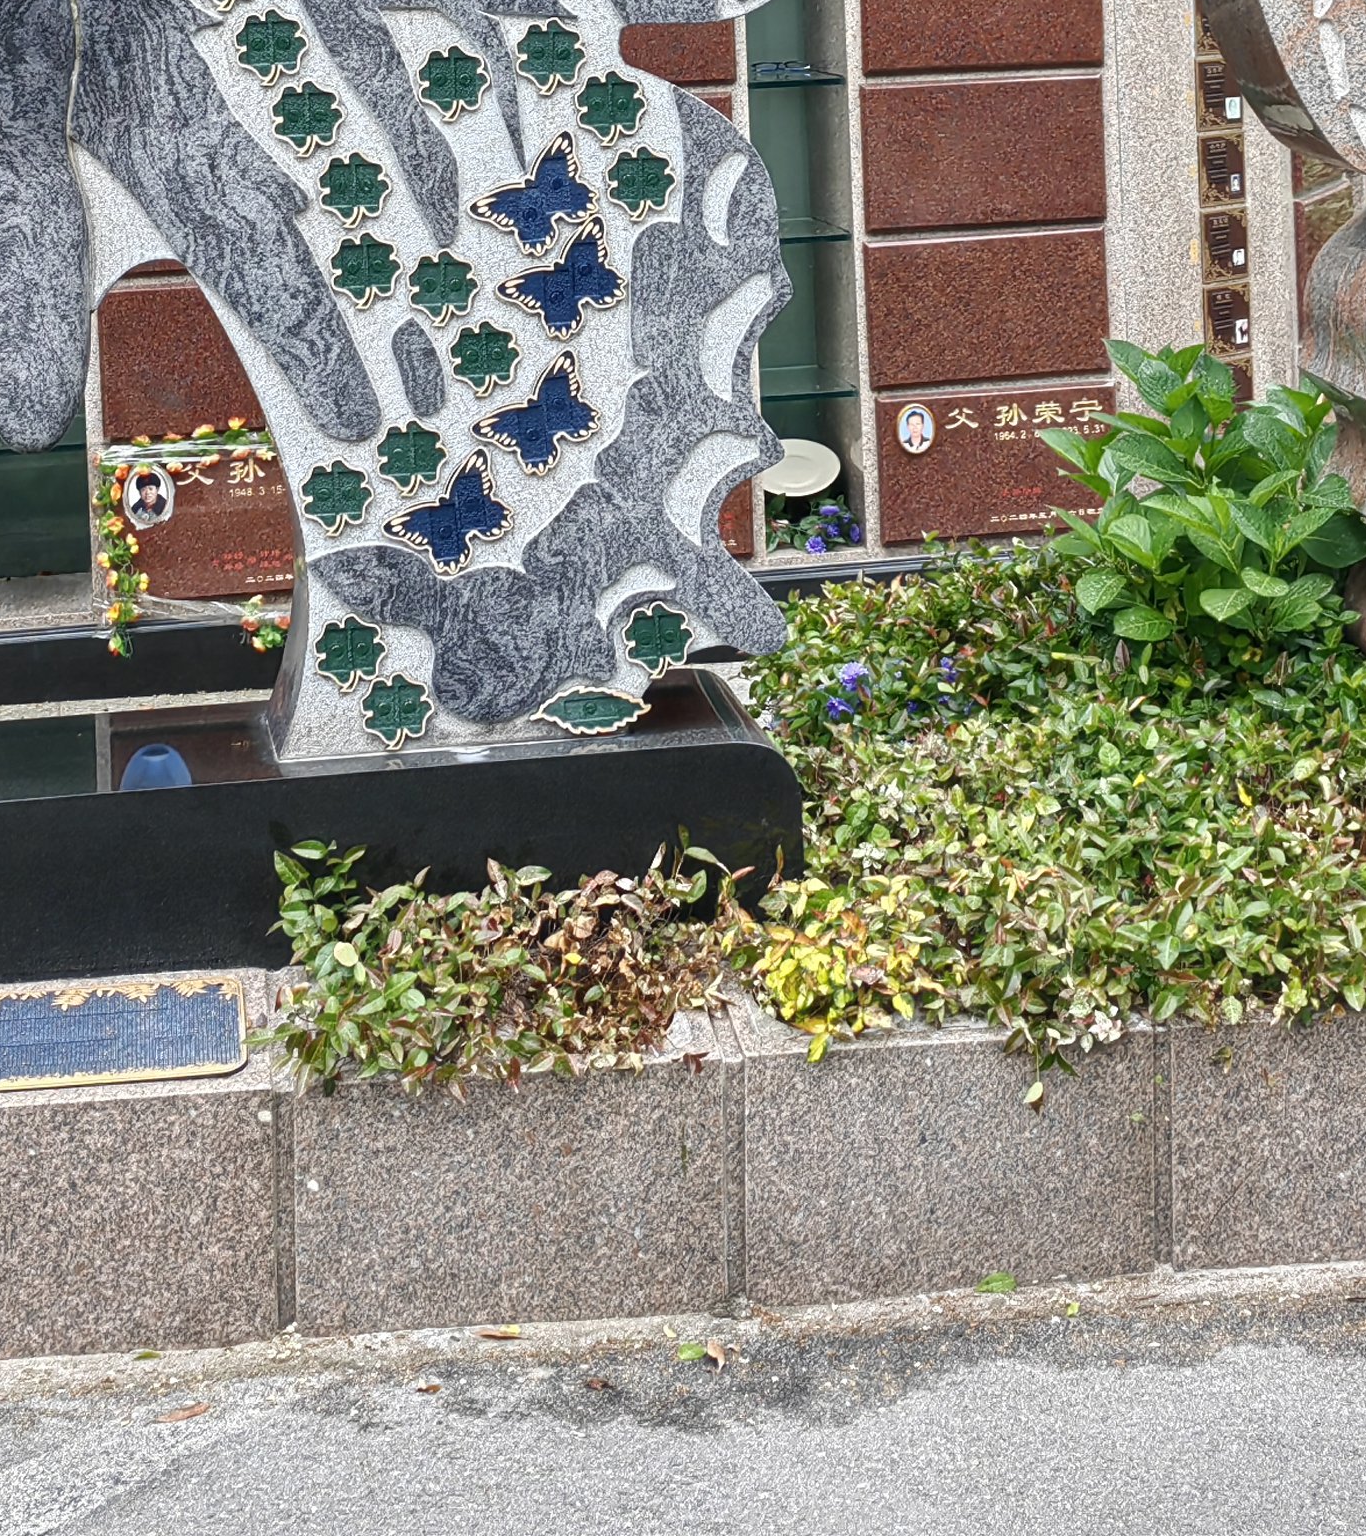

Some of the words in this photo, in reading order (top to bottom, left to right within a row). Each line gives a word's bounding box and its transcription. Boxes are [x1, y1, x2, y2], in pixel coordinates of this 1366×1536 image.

[945, 407, 980, 430] 父
[993, 398, 1103, 427] 孙荣宁
[227, 458, 266, 484] 孙
